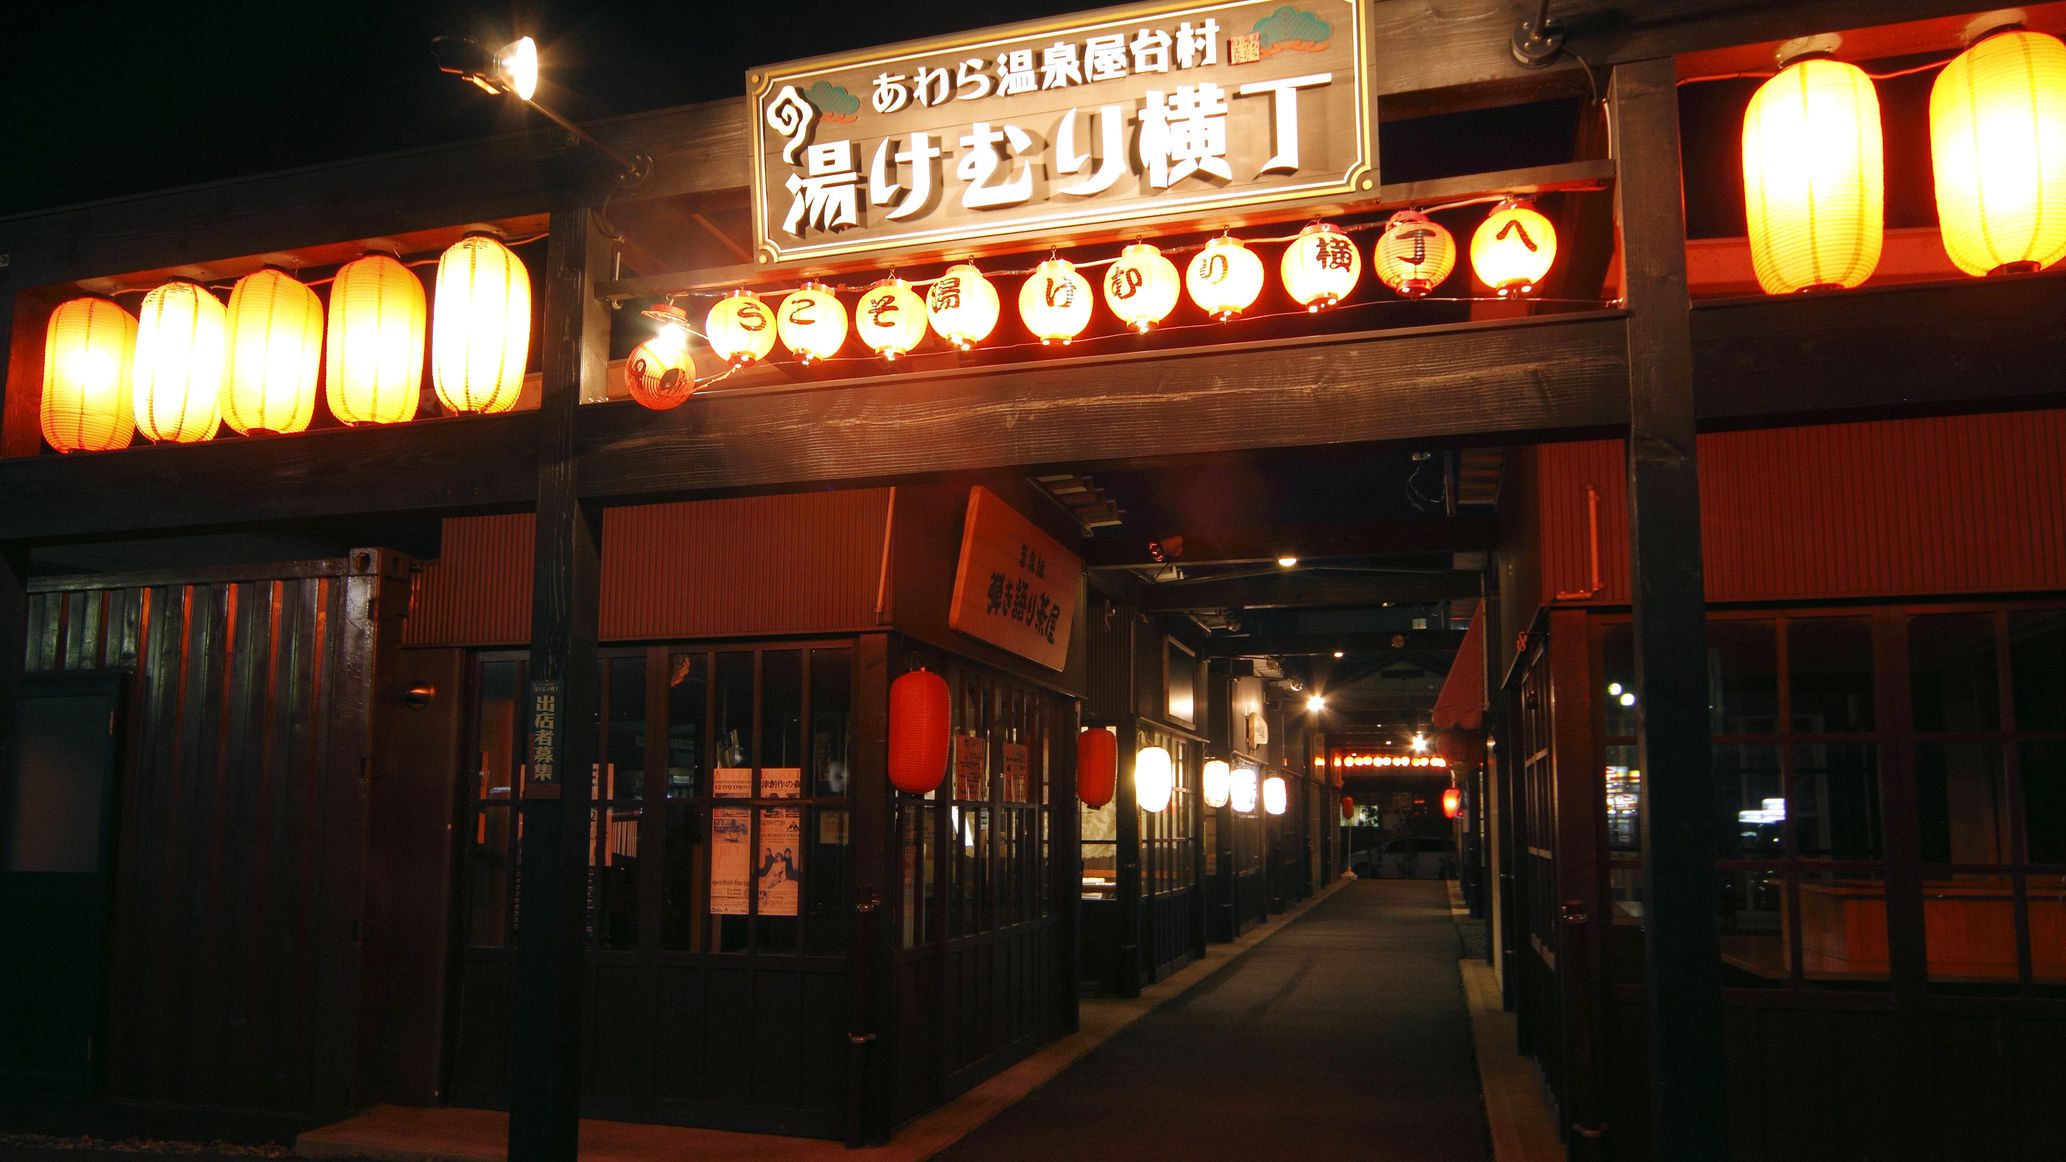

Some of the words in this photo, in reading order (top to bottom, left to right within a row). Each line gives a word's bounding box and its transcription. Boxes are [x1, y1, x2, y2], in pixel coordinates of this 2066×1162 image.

[872, 18, 1221, 114] あわら温泉屋台村
[783, 72, 1332, 235] 湯けむり横丁
[789, 299, 817, 326] こ
[868, 296, 898, 327] そ
[931, 278, 960, 313] 湯
[1046, 277, 1076, 308] け
[1316, 237, 1352, 273] 横
[1396, 230, 1436, 265] 丁
[1496, 220, 1538, 252] へ
[534, 694, 555, 781] 出店者募集
